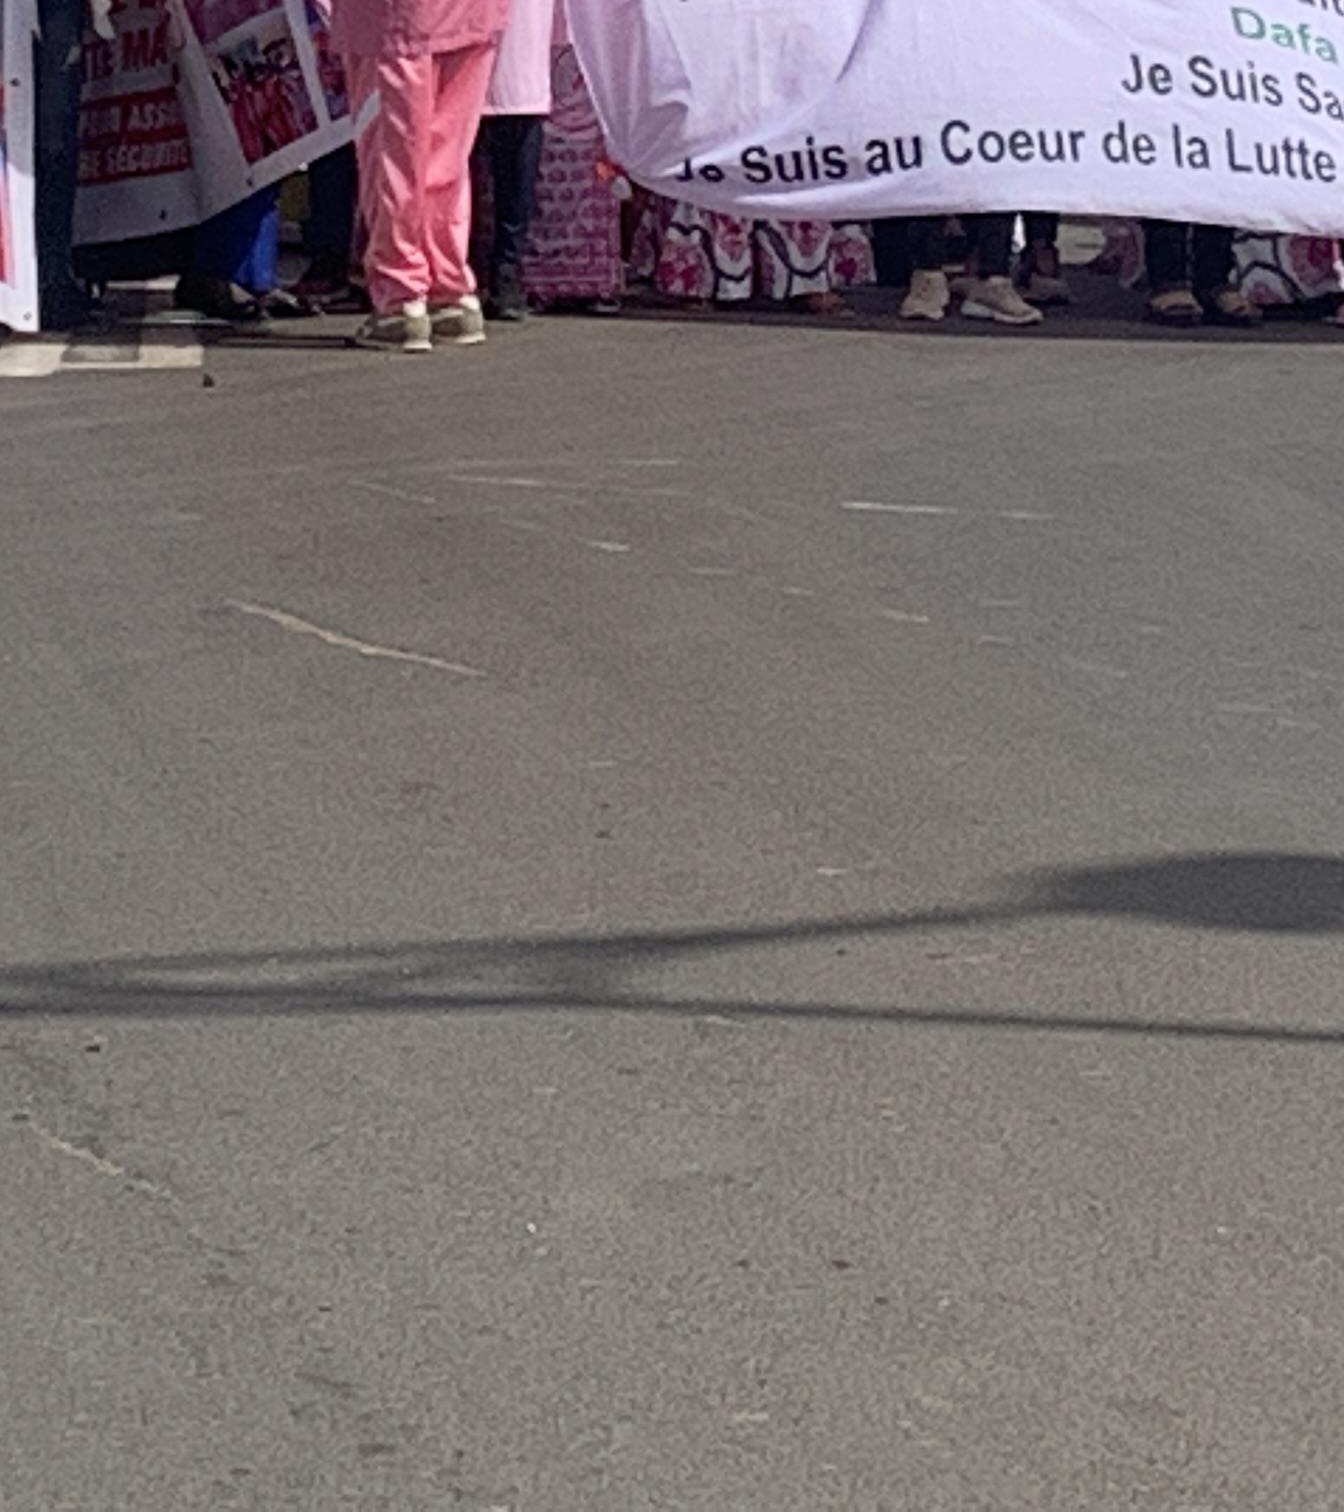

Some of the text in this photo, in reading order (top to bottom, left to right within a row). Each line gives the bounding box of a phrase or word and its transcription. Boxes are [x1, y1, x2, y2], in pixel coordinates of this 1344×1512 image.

[1229, 6, 1339, 67] Dafa
[1121, 53, 1174, 97] Je
[1188, 54, 1284, 109] Suis
[740, 135, 849, 185] Suis
[864, 134, 924, 177] au
[939, 117, 1087, 166] Coeur
[1101, 120, 1158, 166] de
[1172, 123, 1212, 171] la
[1224, 127, 1338, 185] Lutte
